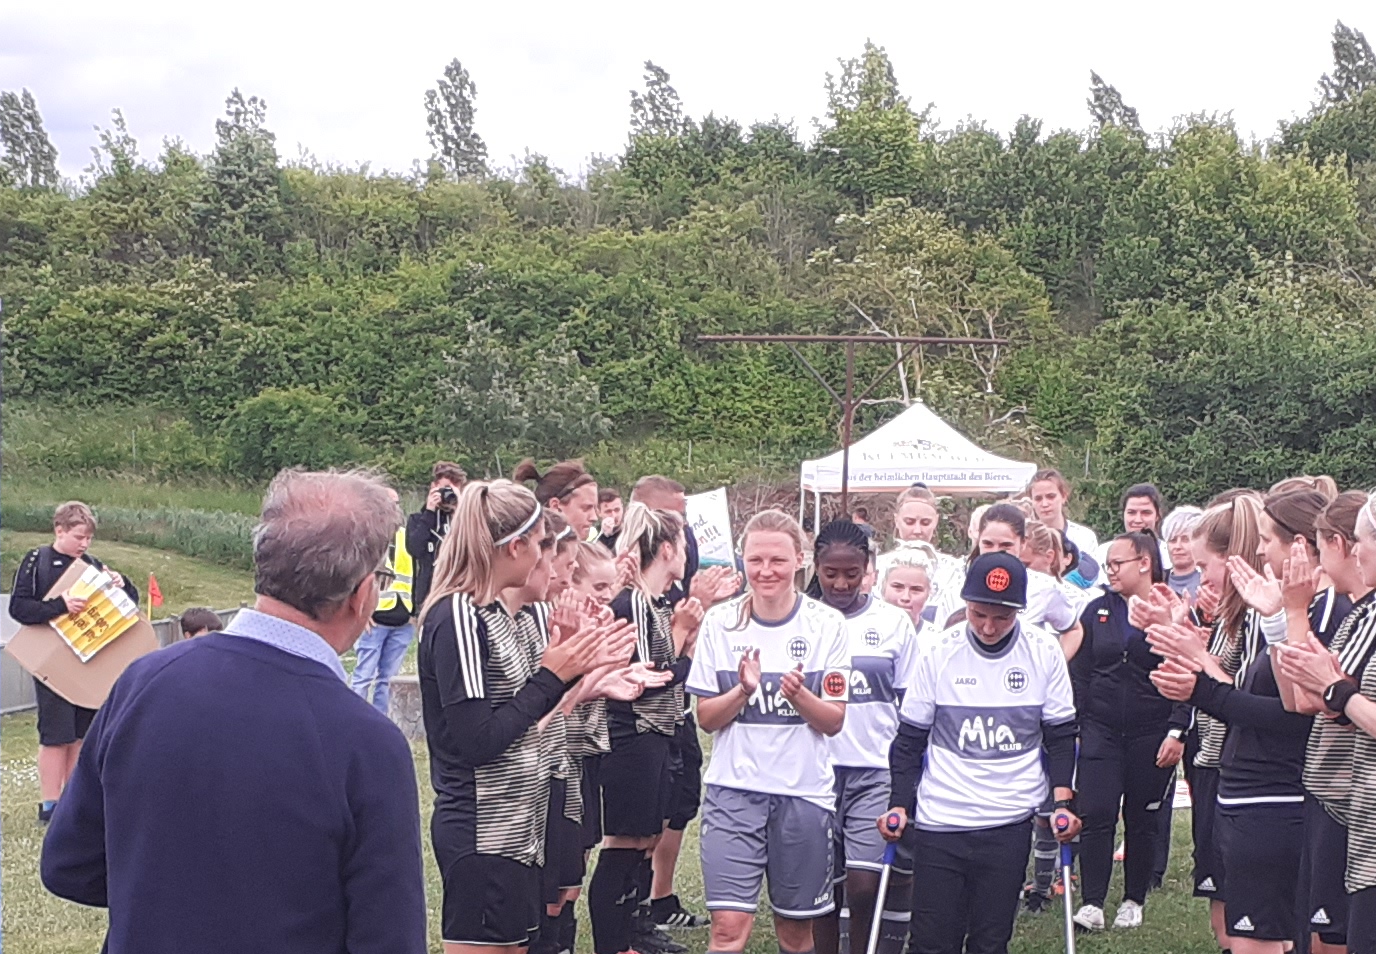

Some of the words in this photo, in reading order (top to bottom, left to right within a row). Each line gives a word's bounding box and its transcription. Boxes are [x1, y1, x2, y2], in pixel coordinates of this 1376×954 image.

[955, 677, 977, 686] JAKO
[957, 715, 1016, 751] Mia
[999, 742, 1022, 751] KLUB
